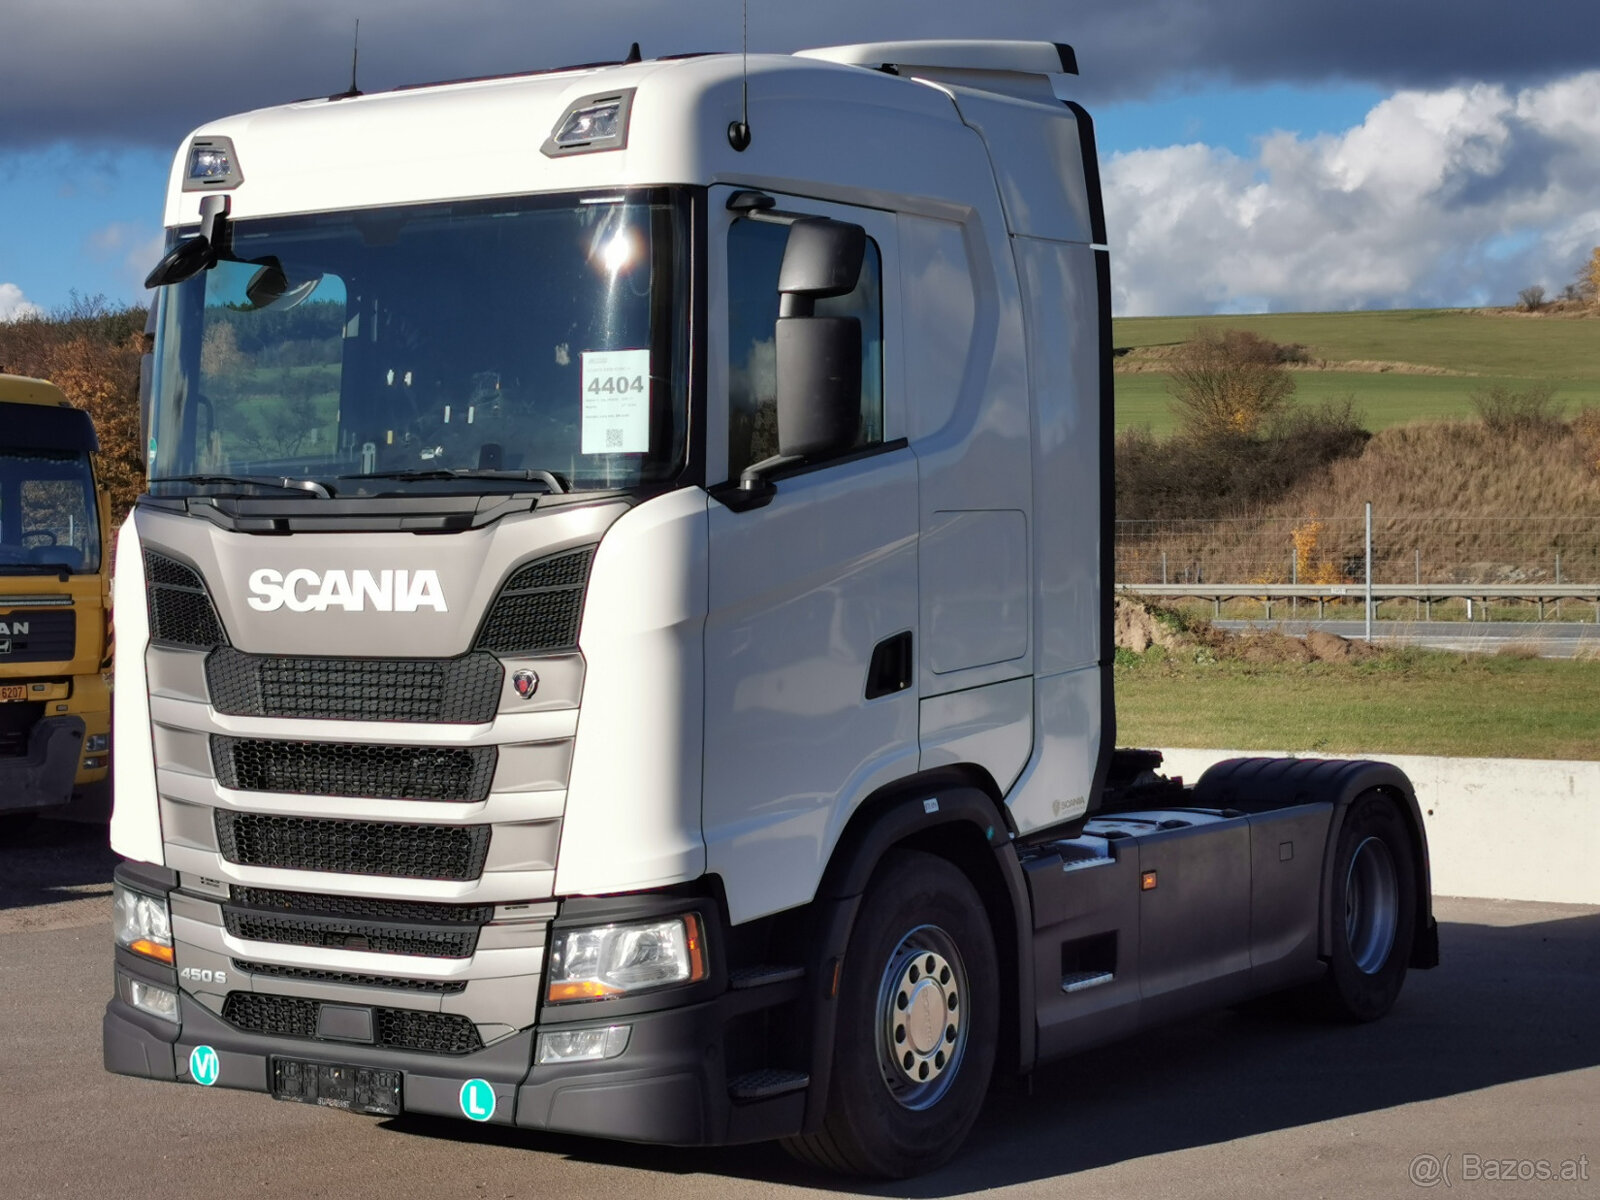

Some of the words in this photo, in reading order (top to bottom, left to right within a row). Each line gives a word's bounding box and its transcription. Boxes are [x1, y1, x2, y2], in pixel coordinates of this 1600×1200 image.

[587, 375, 644, 395] 4404
[247, 568, 449, 613] SCANIA
[2, 687, 23, 698] 6207
[180, 968, 213, 982] 450
[214, 971, 227, 984] S
[194, 1051, 216, 1080] VI
[469, 1086, 486, 1115] L
